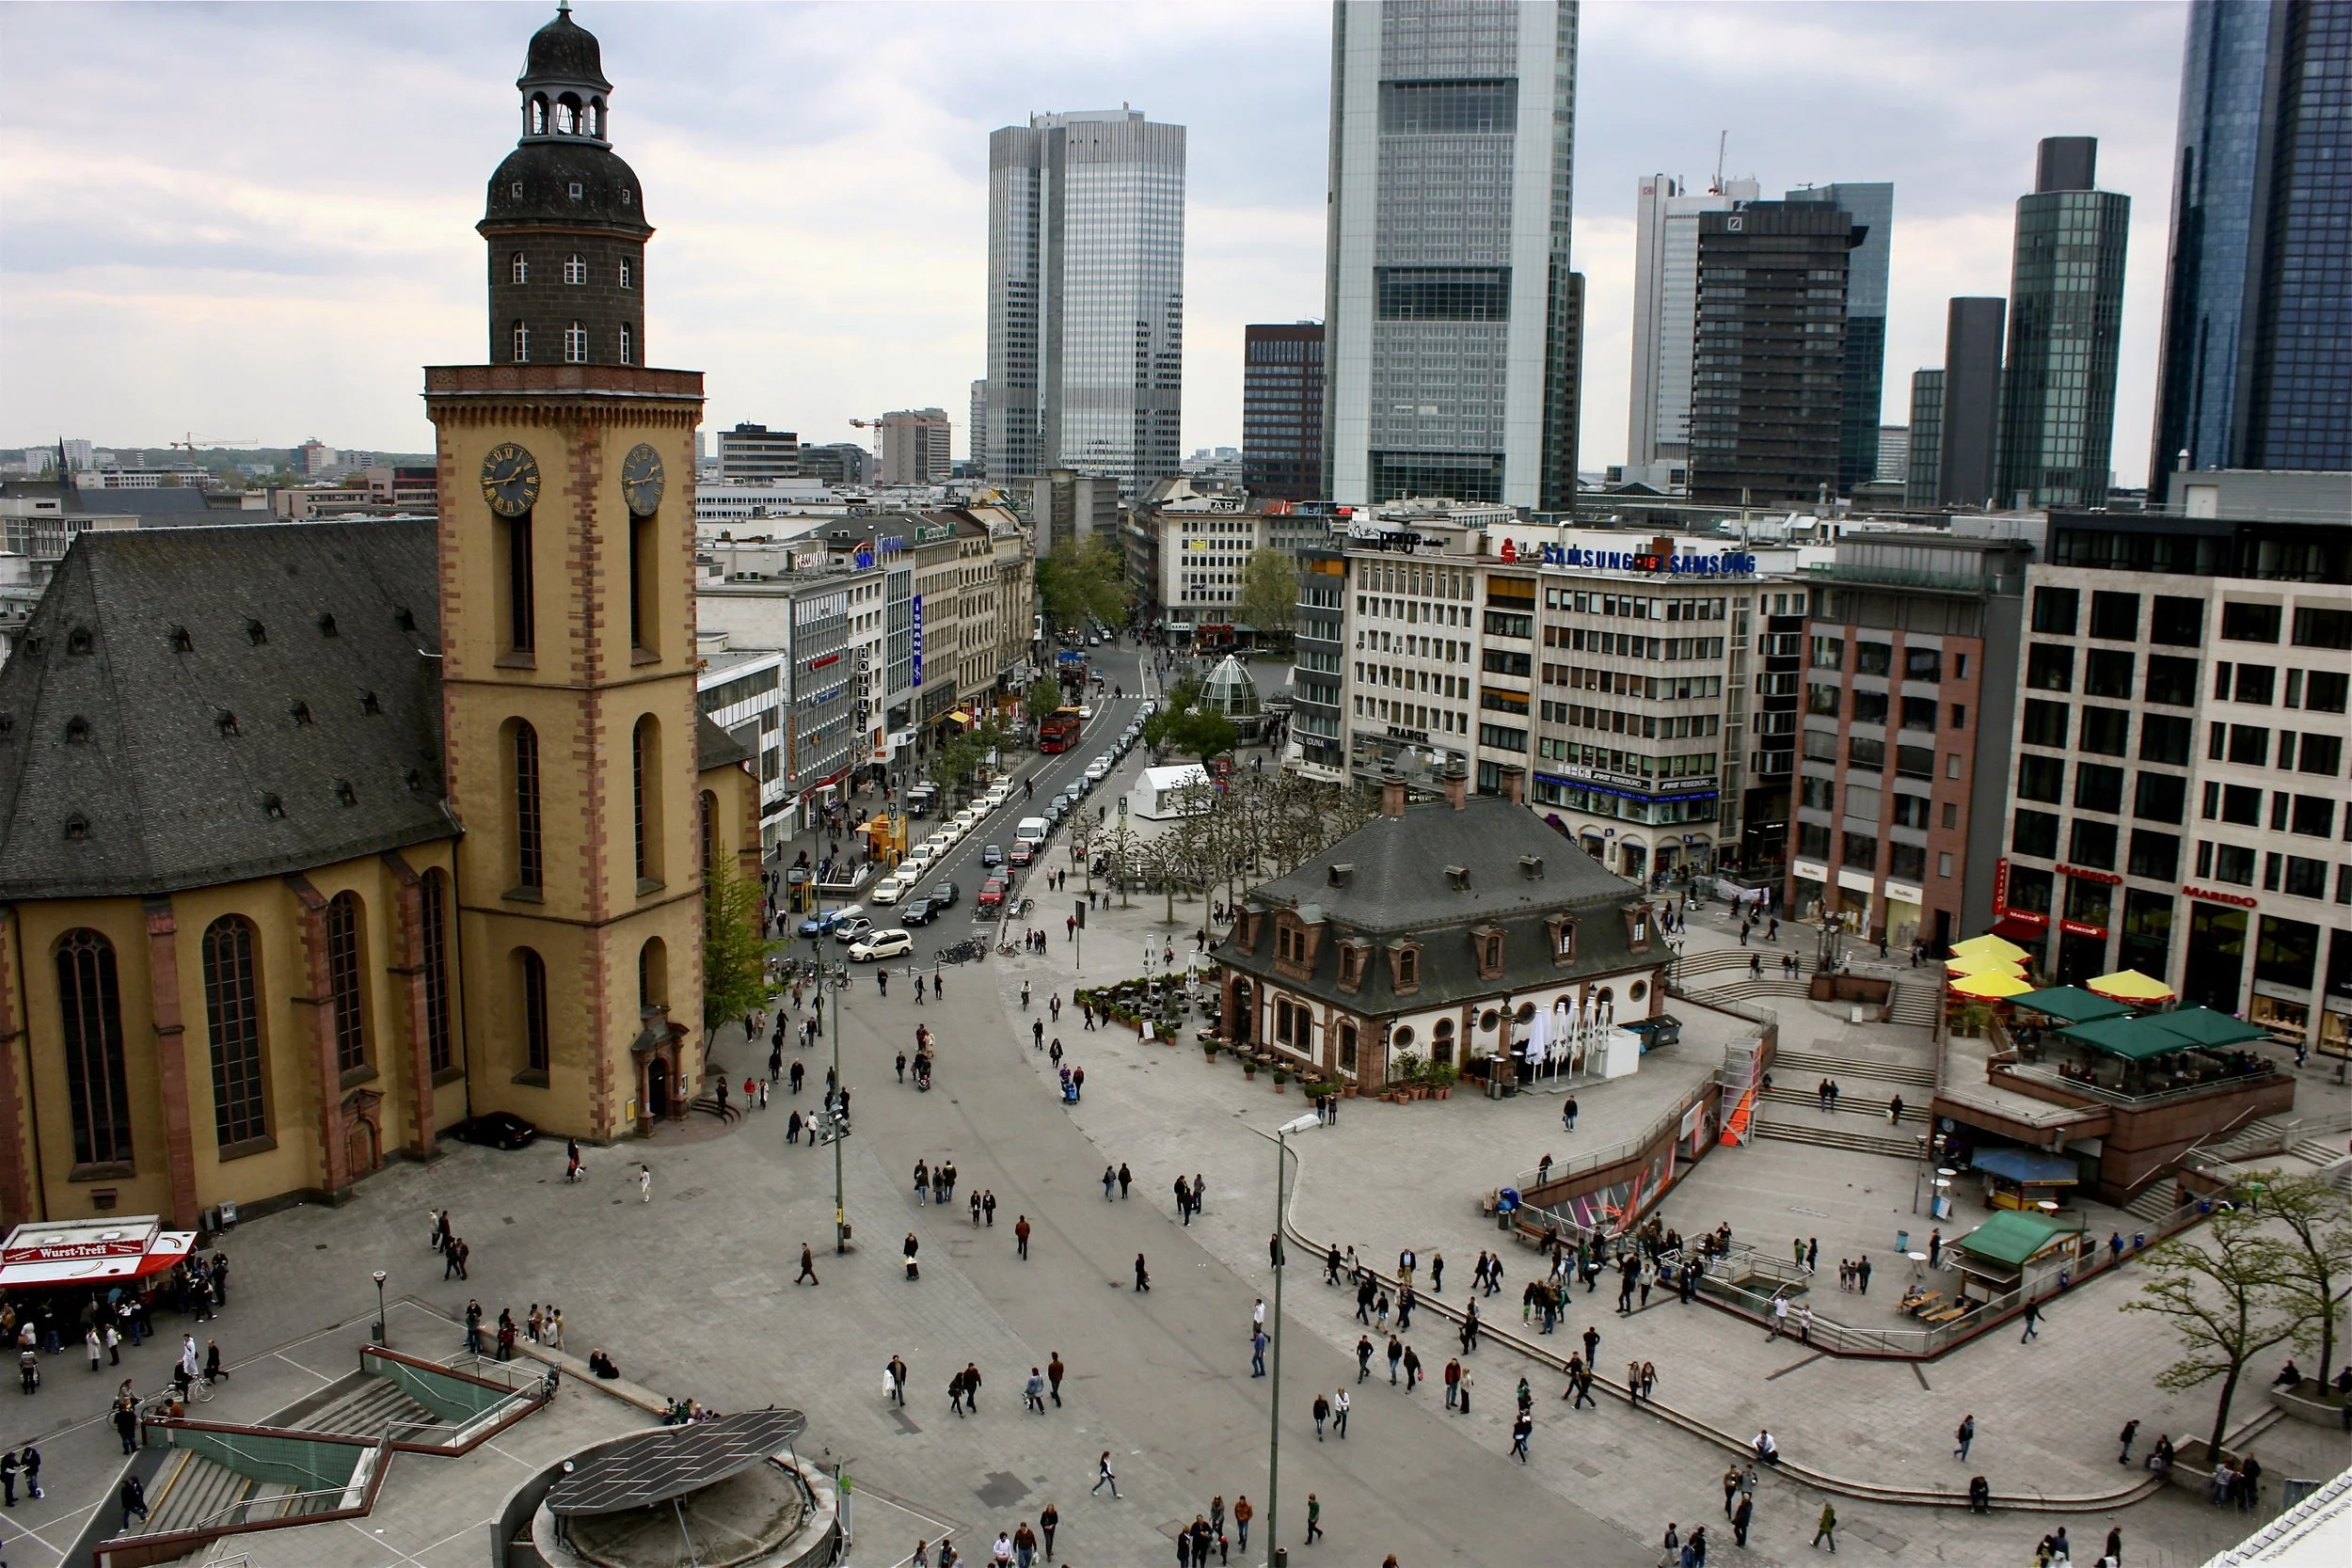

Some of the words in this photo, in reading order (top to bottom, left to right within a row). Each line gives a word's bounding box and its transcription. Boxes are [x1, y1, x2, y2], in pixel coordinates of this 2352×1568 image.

[1379, 531, 1422, 554] prange
[1544, 544, 1632, 569] SAMSUNG
[1669, 554, 1756, 574] SAMSUNG
[858, 648, 868, 709] HOTEL
[1306, 737, 1325, 748] IDUNA
[1387, 726, 1429, 742] PRANGE
[1593, 773, 1611, 782] FIRST
[889, 811, 897, 819] U
[1997, 860, 2008, 902] MAREDO
[2056, 863, 2122, 885] MAREDO
[2182, 886, 2257, 908] MAREDO
[2010, 911, 2040, 922] MAREDO
[2066, 924, 2097, 935] MAREDO
[40, 1244, 107, 1258] Wurst-Treff
